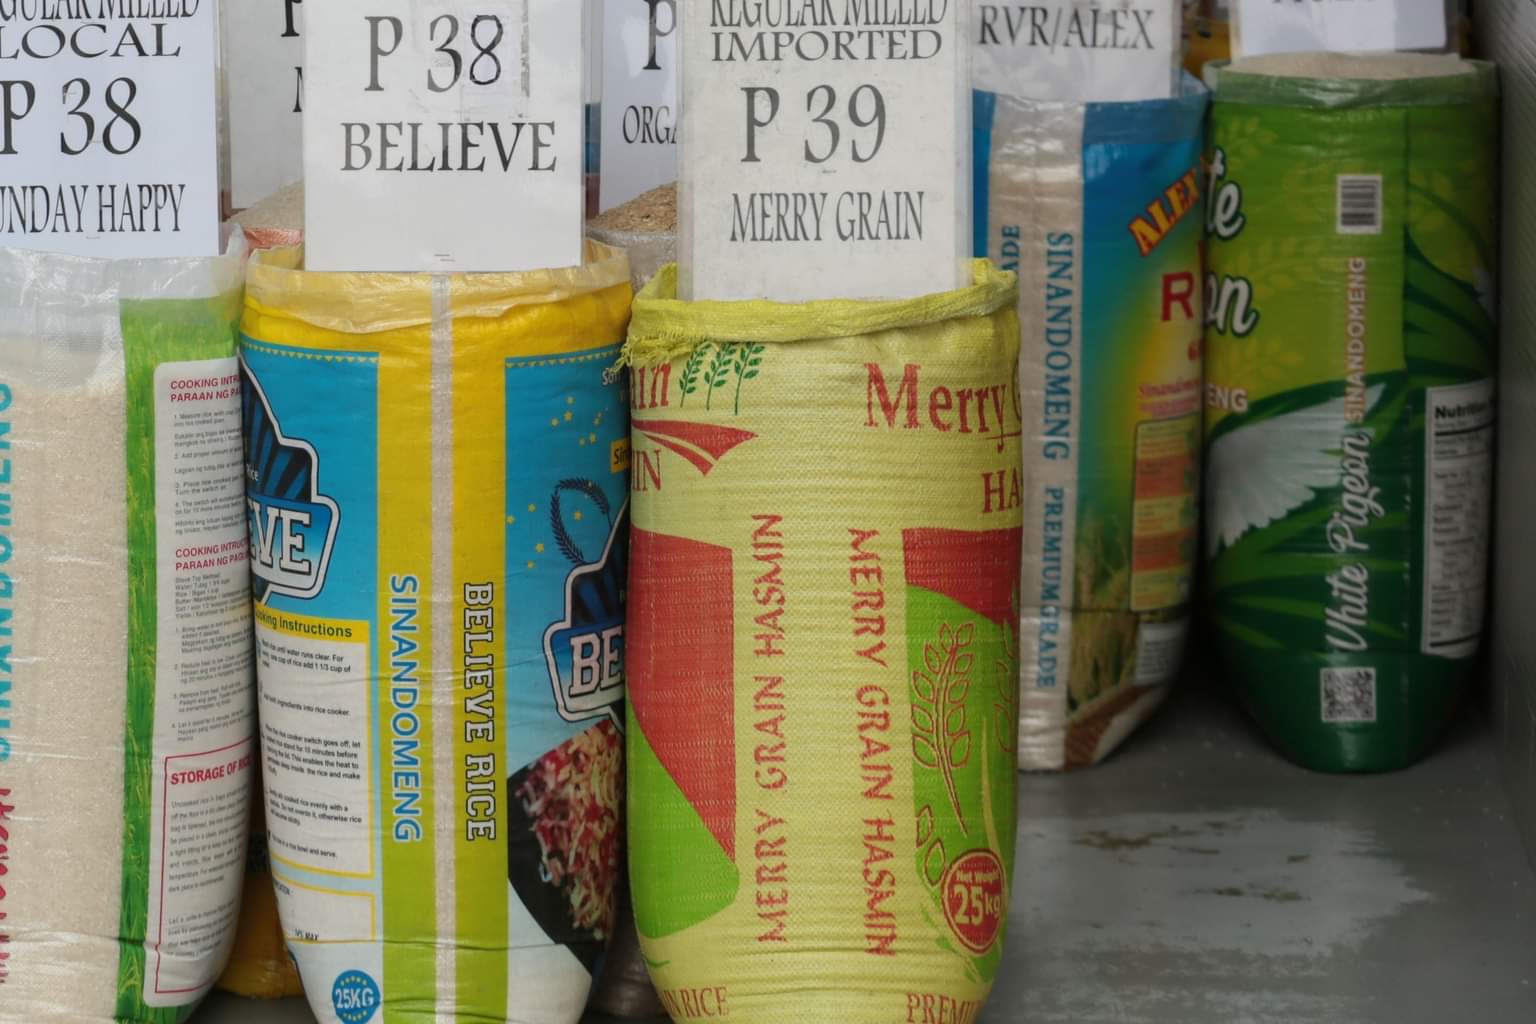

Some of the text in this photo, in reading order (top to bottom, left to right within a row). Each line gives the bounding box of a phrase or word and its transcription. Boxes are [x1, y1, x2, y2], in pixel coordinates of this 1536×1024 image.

[364, 14, 503, 92] P 38
[712, 30, 942, 61] IMPORTED
[978, 5, 1155, 51] RVR/ALEX
[60, 77, 141, 156] 38
[741, 85, 886, 164] P 39
[340, 121, 557, 173] BELIEVE
[97, 183, 185, 234] HAPPY
[730, 191, 924, 242] MERRY GRAIN
[1043, 232, 1073, 460] SINANDOMENG
[1344, 257, 1366, 422] SINANDOMENG
[170, 378, 219, 389] COOKING
[170, 391, 213, 403] PARAAN
[864, 362, 1007, 452] Merry
[1327, 430, 1386, 553] Pigeon
[175, 545, 219, 558] COOKING
[175, 559, 215, 571] PARAAN
[279, 616, 353, 638] Instructions
[390, 574, 423, 843] SINANDOMENG
[463, 582, 497, 841] BELIEVE RICE
[751, 513, 789, 944] MERRY GRAIN HASMIN
[848, 528, 897, 958] MERRY GRAIN HASMIN
[170, 764, 225, 786] STORAGE
[335, 988, 374, 1009] 25KG
